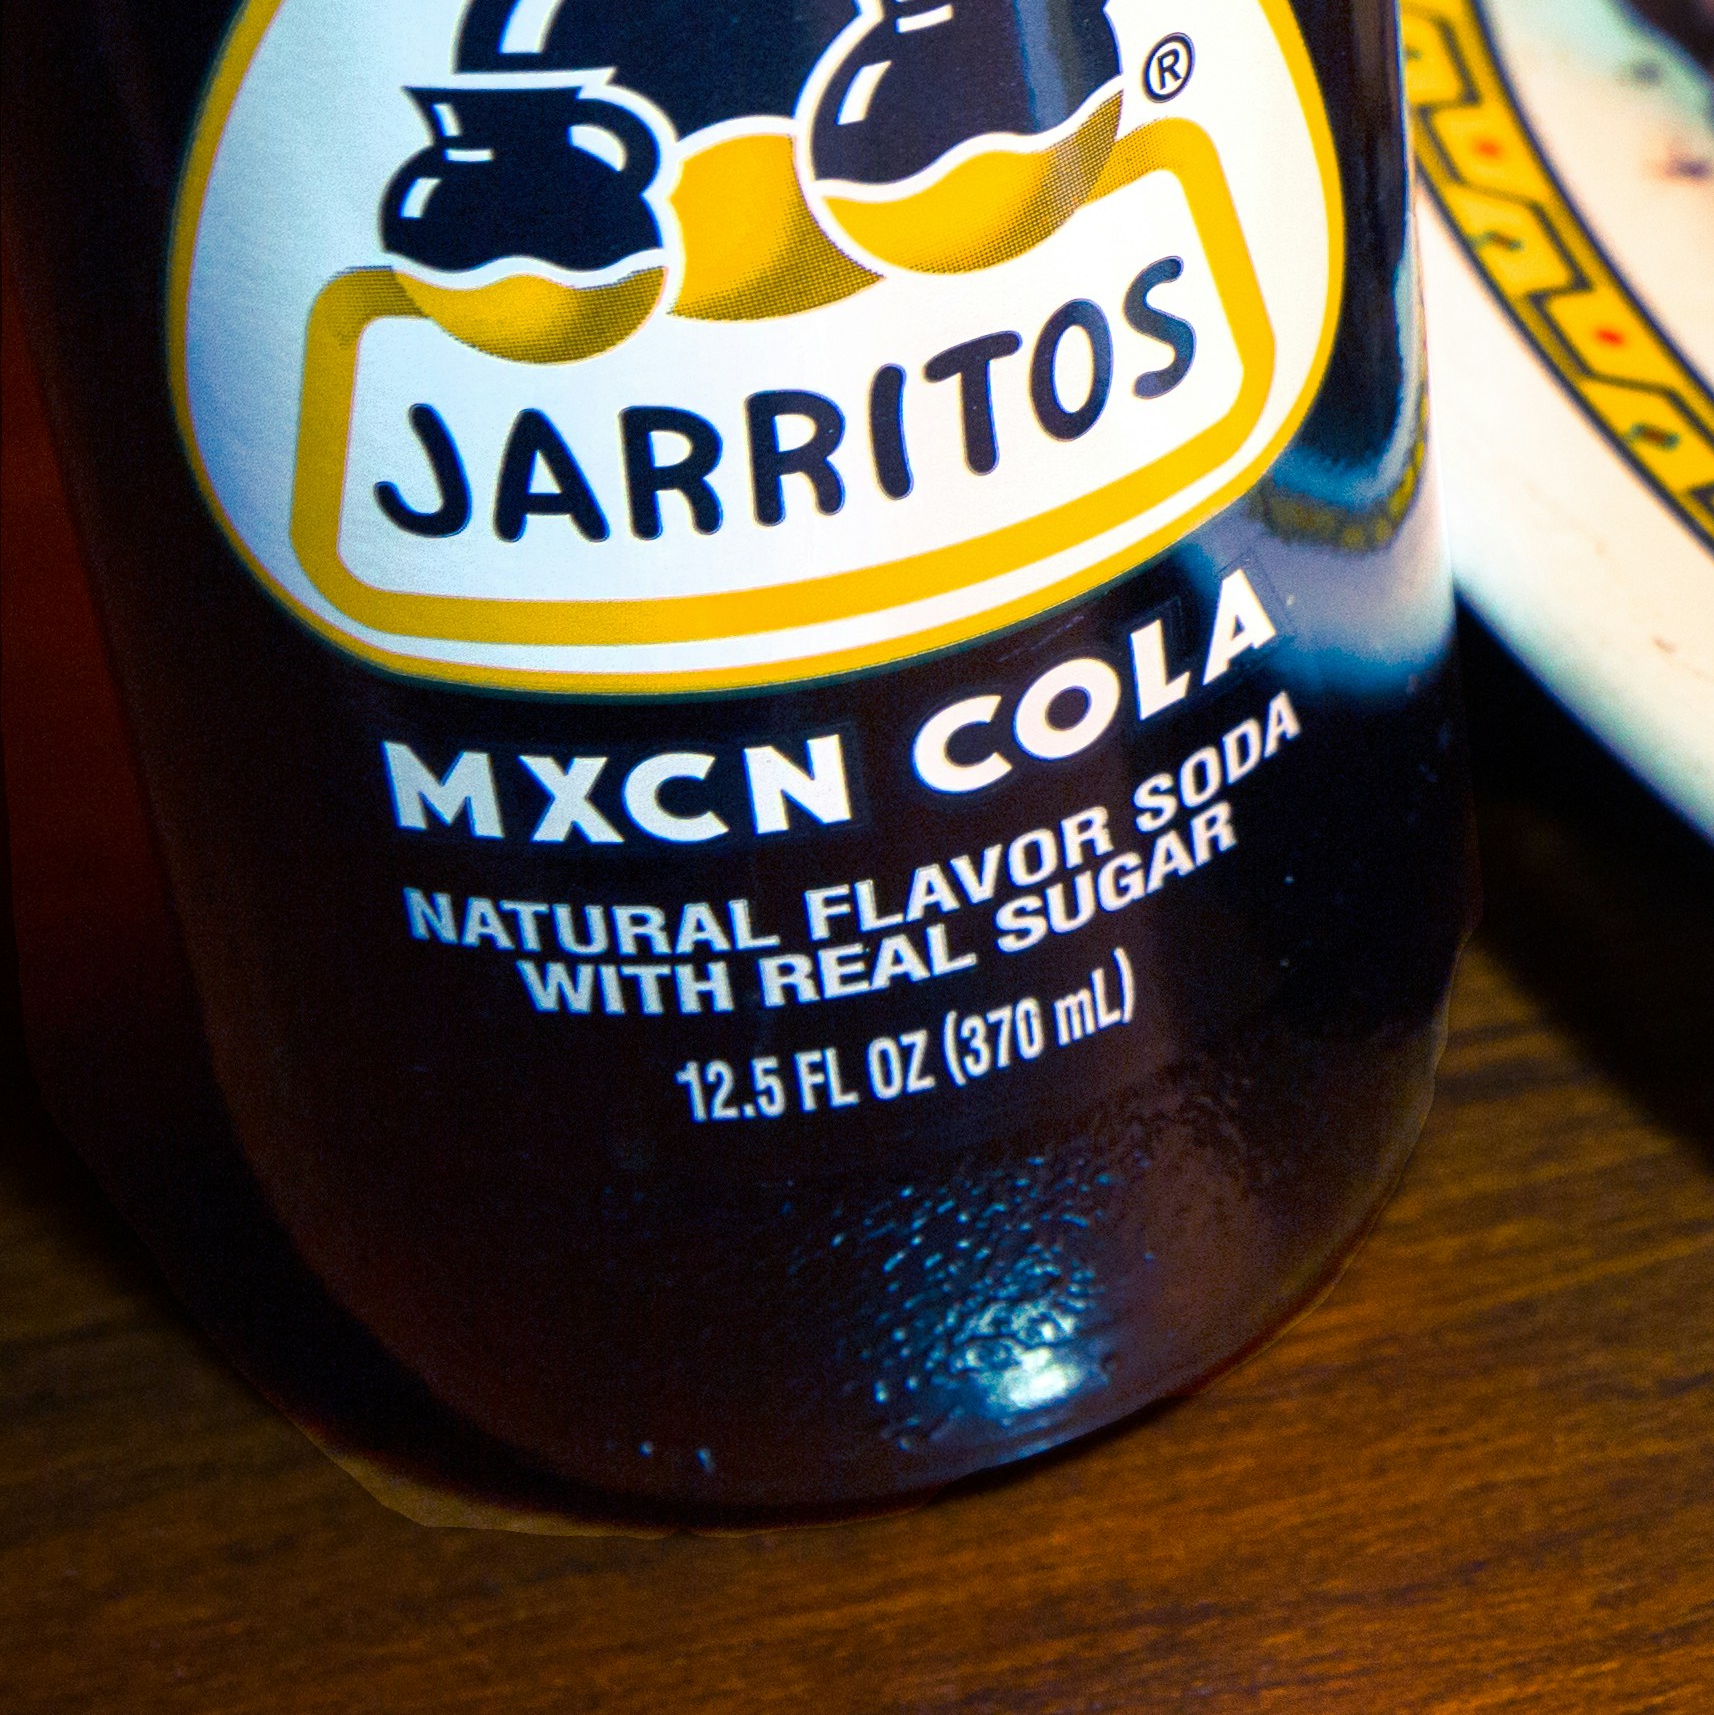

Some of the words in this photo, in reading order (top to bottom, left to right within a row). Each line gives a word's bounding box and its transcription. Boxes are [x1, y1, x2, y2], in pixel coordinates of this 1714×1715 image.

[373, 255, 1197, 543] JARRITOS
[381, 733, 853, 844] MXCN
[911, 567, 1277, 794] COLA
[403, 886, 780, 957] NATURAL
[805, 805, 1114, 942] FLAVOR
[1132, 690, 1303, 832] SODA
[517, 958, 735, 1016] WITH
[758, 923, 979, 1009] REAL
[995, 800, 1240, 953] SUGAR
[676, 1055, 786, 1124] 12.5
[798, 1048, 859, 1114] FL
[868, 1028, 935, 1101] OZ
[944, 985, 1045, 1087] (370
[1054, 946, 1136, 1039] mL)
